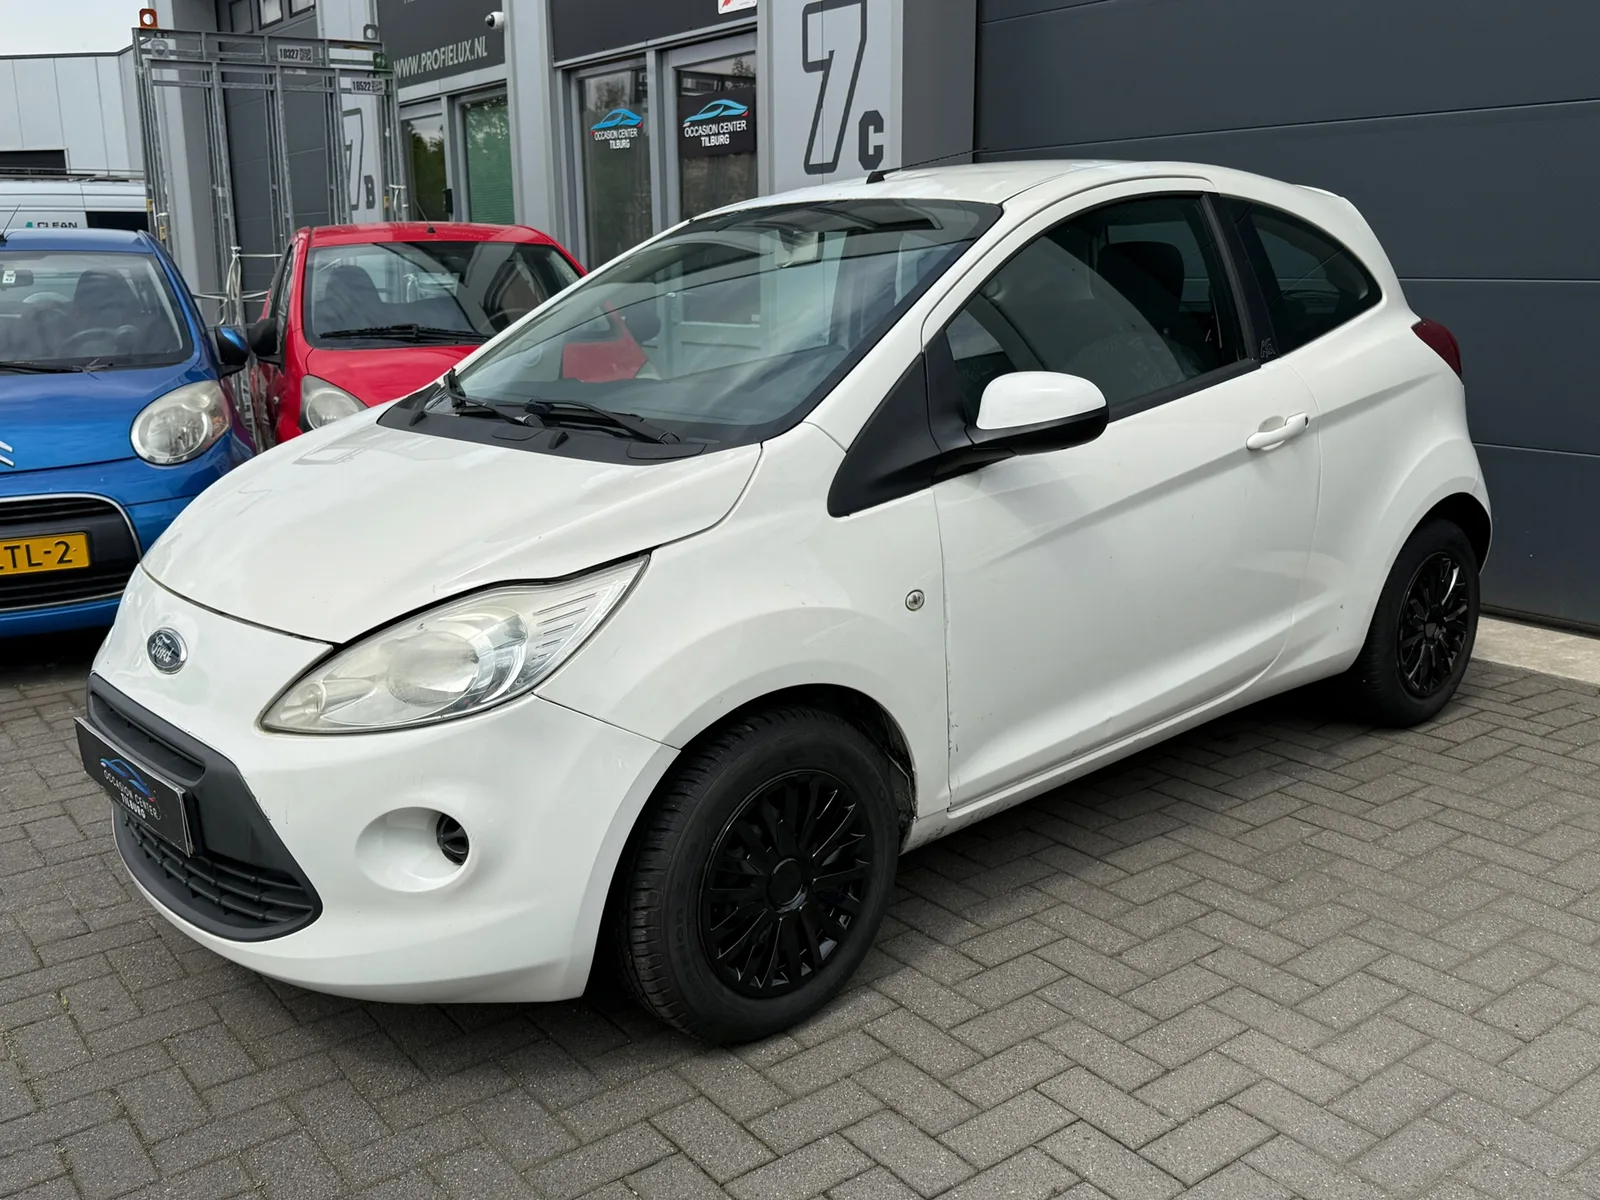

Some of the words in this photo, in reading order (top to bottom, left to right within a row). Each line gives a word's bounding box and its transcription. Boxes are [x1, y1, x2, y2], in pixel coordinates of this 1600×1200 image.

[393, 35, 488, 79] WWW.PROFIELUX.NL
[594, 129, 618, 141] OCCASION
[618, 127, 638, 139] CENTER
[684, 123, 718, 137] OCCASION
[719, 119, 747, 133] CENTER
[701, 134, 730, 147] TILBURG
[609, 138, 631, 150] TILBURG
[0, 540, 73, 570] TL-2
[151, 633, 175, 663] Ford
[103, 769, 134, 801] OCCASION
[134, 793, 161, 821] CENTER
[120, 792, 146, 820] TILBURG
